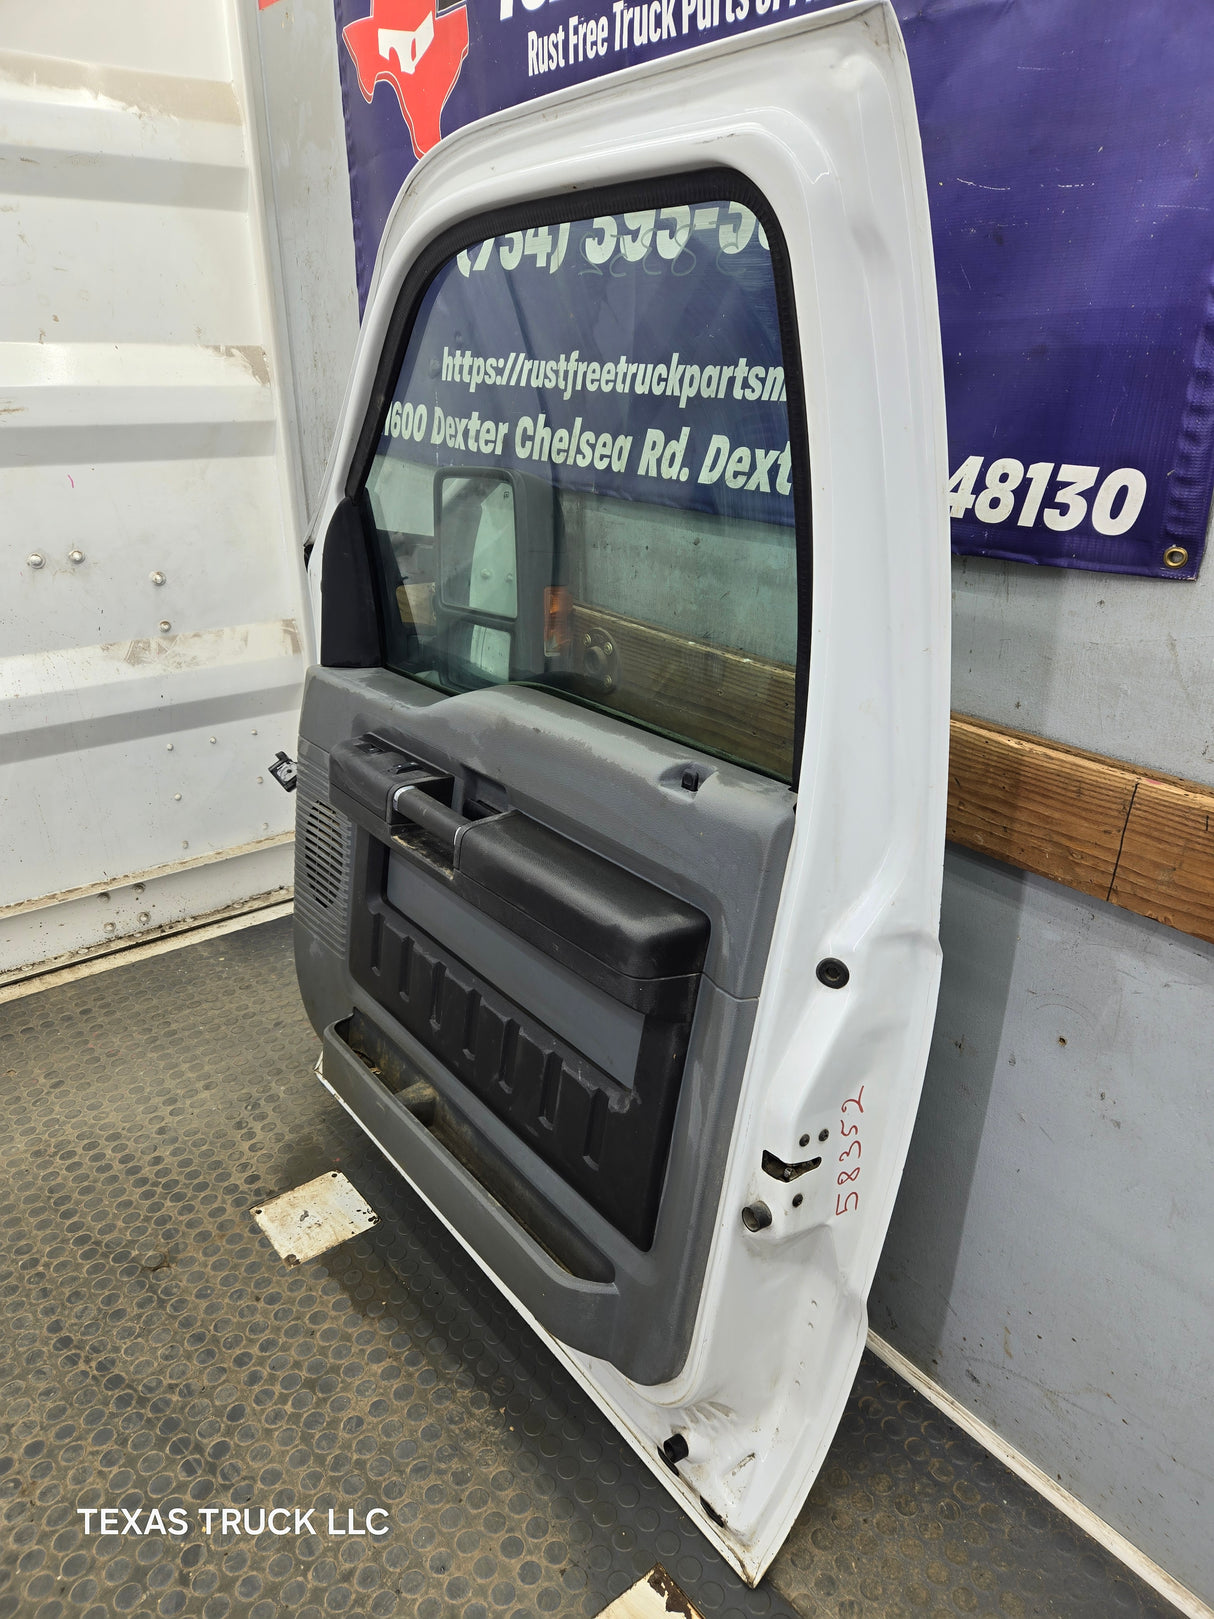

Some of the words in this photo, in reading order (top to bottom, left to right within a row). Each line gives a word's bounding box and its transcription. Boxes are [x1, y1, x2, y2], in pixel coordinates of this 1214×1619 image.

[527, 25, 566, 77] Rust
[568, 15, 609, 65] Free
[612, 0, 677, 52] Truck
[430, 406, 509, 455] Dexter
[514, 413, 633, 473] Chelsea
[637, 426, 691, 482] Rd.
[697, 434, 792, 496] Dext
[948, 455, 1147, 536] 48130
[835, 1085, 865, 1216] 58352
